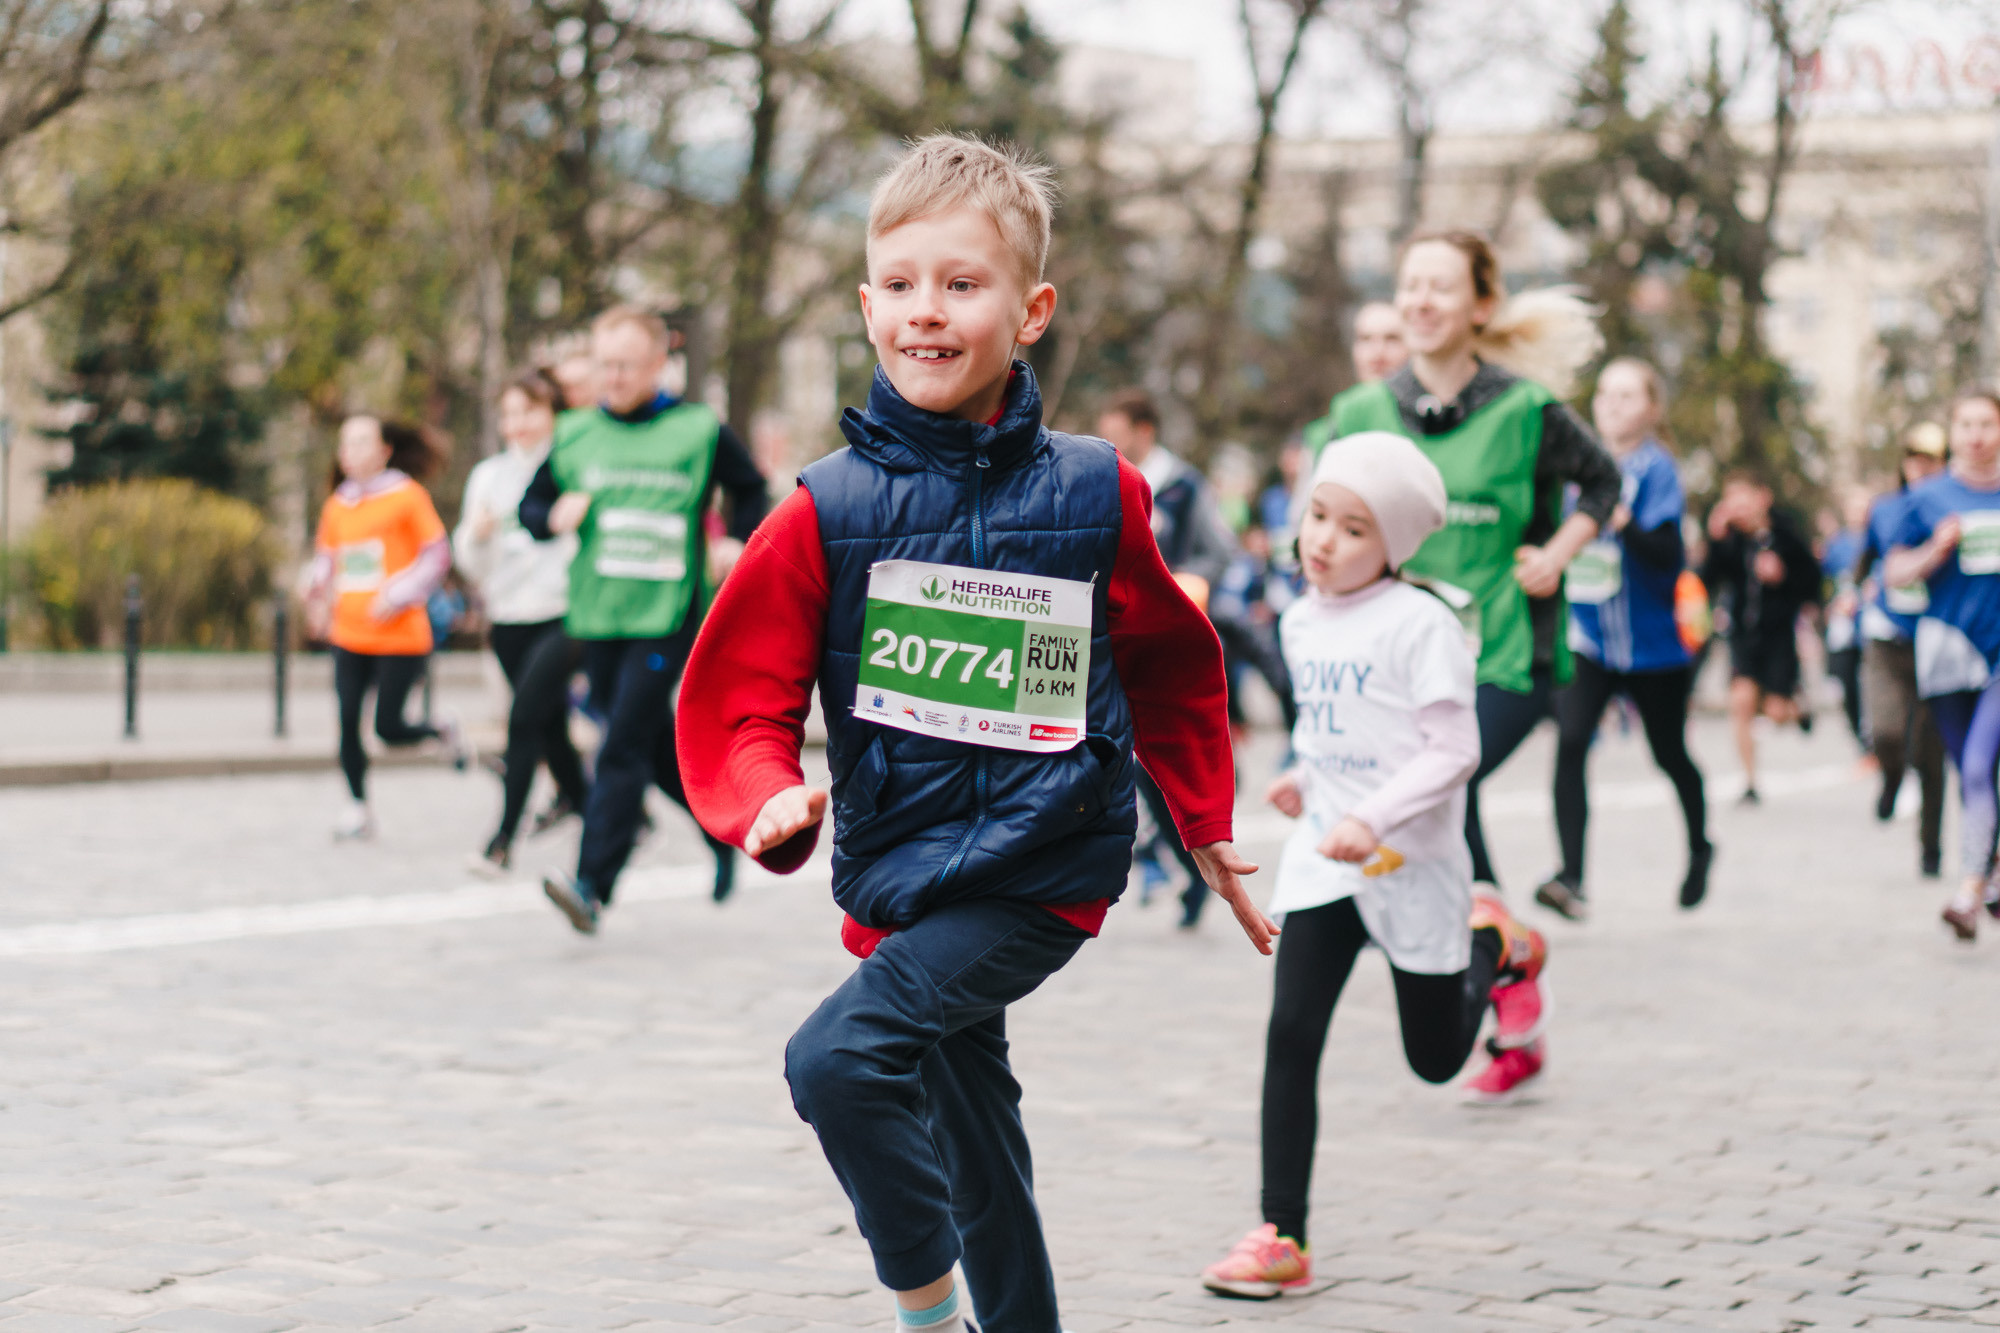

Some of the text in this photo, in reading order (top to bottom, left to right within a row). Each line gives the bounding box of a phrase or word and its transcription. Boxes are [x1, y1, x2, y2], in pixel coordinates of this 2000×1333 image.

[951, 579, 1052, 602] HERBALIFE
[950, 592, 1052, 616] NUTRITION
[1029, 633, 1079, 650] FAMILY
[868, 628, 1015, 690] 20774
[1027, 647, 1078, 673] RUN
[1024, 677, 1075, 697] 1,6 KM
[1296, 659, 1373, 695] OWY
[992, 729, 1021, 737] AIRLINES
[993, 721, 1022, 730] TURKISH
